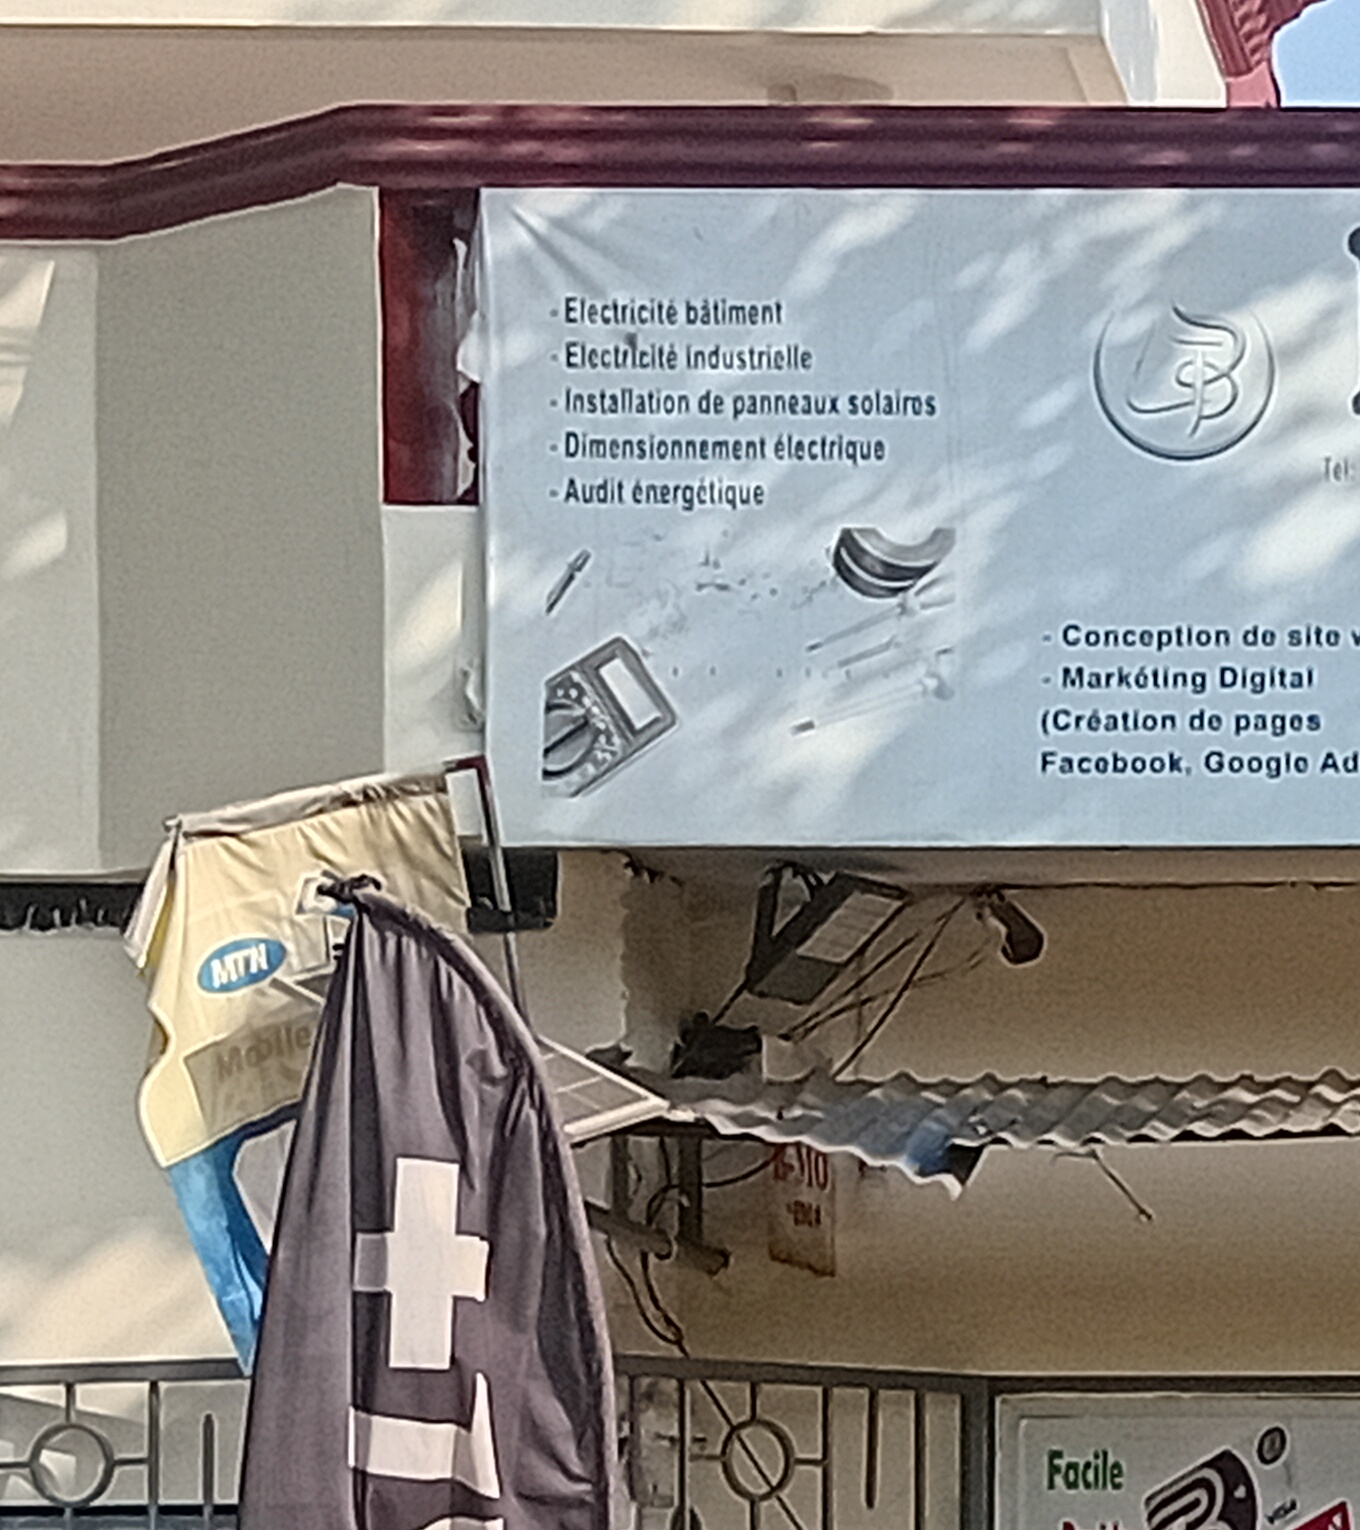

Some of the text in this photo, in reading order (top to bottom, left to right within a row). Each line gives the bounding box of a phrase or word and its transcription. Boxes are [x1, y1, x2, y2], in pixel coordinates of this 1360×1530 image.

[564, 296, 784, 326] Electricité bâtiment
[565, 342, 813, 371] Electricité industrielle
[564, 388, 690, 415] Installation
[697, 389, 724, 415] de
[732, 393, 840, 420] panneaux
[564, 432, 886, 467] Dimensionnement électrique
[564, 478, 765, 511] Audit énergétique
[1061, 624, 1231, 652] Conception
[1241, 624, 1276, 648] de
[1287, 624, 1340, 648] site
[1218, 666, 1315, 694] Digital
[1040, 708, 1322, 736] (Création de pages
[1040, 751, 1193, 777] Facebook,
[1204, 751, 1309, 779] Google
[210, 942, 269, 989] MTN
[1047, 1448, 1124, 1490] Facile
